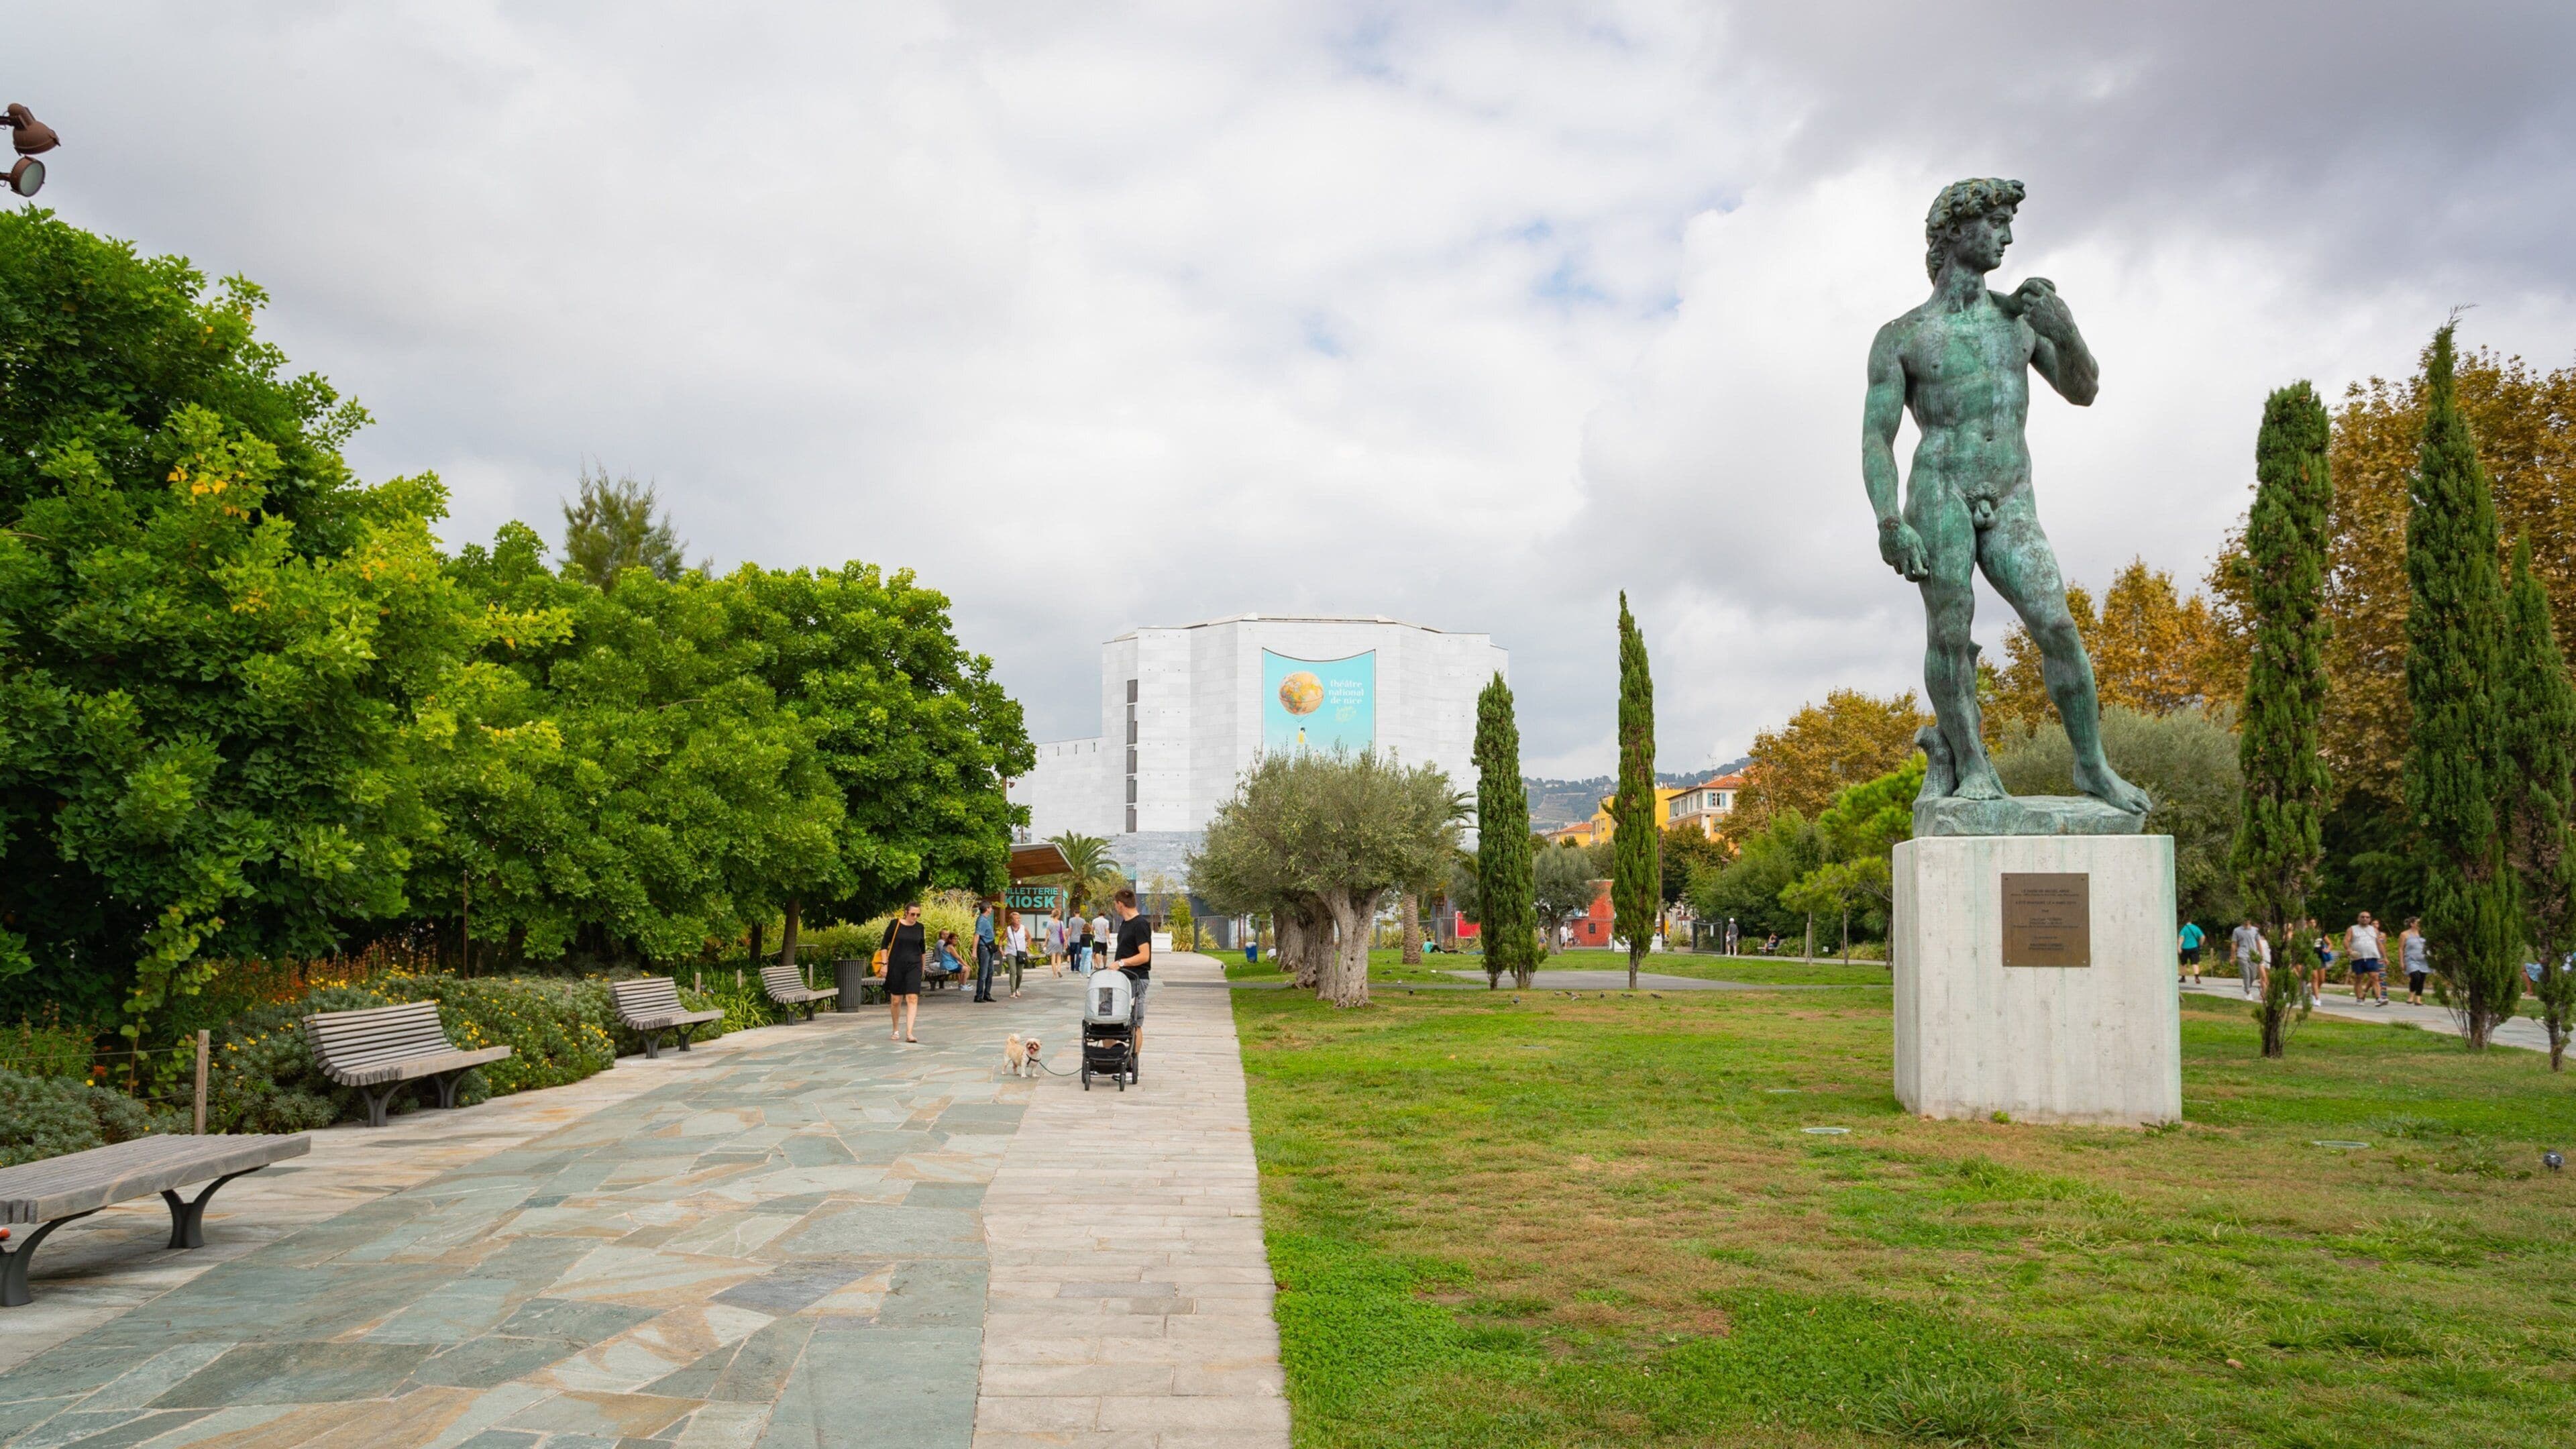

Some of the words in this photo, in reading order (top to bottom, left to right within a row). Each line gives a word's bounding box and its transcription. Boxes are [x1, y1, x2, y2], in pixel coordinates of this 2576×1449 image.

[1328, 688, 1364, 696] national
[1004, 887, 1059, 895] ILLETTERIE
[1005, 896, 1055, 908] KIOSK
